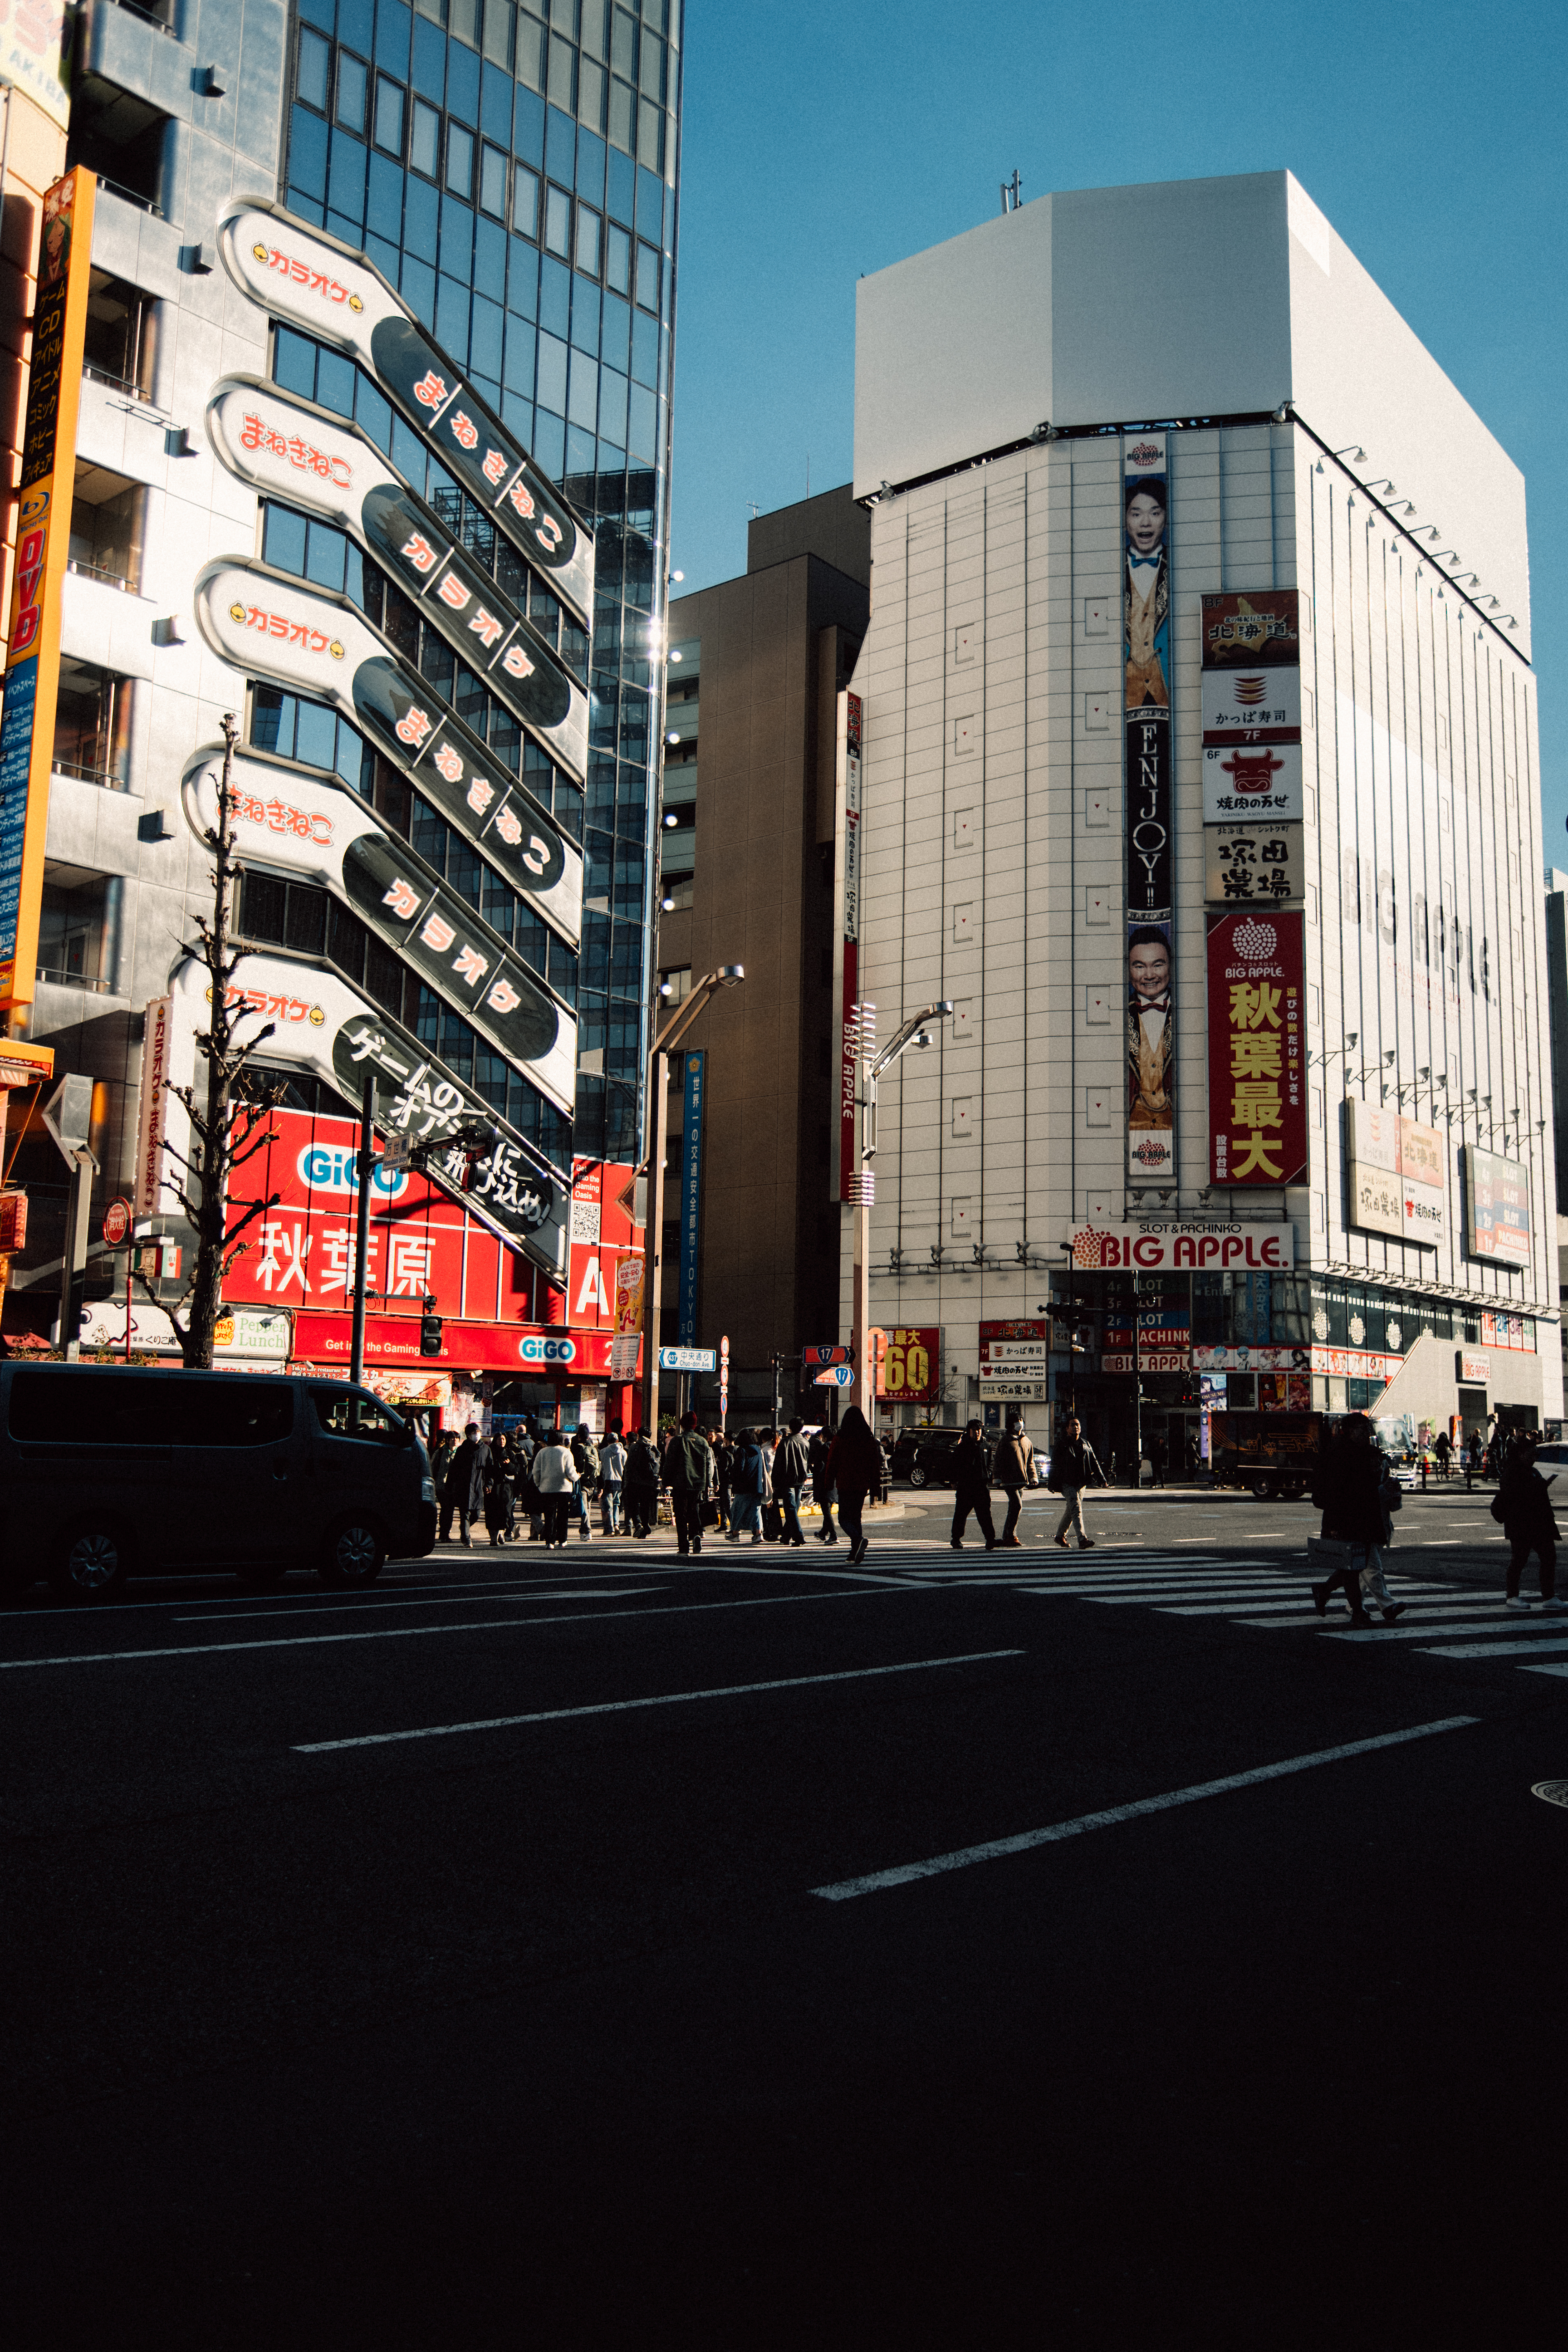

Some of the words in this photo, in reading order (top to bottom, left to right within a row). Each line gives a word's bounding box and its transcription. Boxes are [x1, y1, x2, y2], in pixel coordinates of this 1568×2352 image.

[268, 248, 350, 305] カラオケ
[39, 310, 61, 340] CD
[34, 336, 62, 371] アイドル
[31, 363, 61, 401] アニメ
[29, 394, 57, 425] コミック
[29, 427, 54, 455] ホビー
[239, 412, 354, 490] まねきねこ
[1127, 452, 1140, 461] BIG
[1142, 451, 1164, 459] APPLE
[25, 452, 52, 483] フィギュア
[414, 370, 563, 552] まねきねこ
[11, 527, 46, 654] DVD
[401, 532, 535, 679] カラオケ
[1204, 597, 1223, 608] 8F
[1224, 614, 1275, 624] 北の味紀行と地酒
[246, 607, 330, 654] カラオケ
[1209, 622, 1291, 641] 北海道
[848, 699, 860, 745] 北海道
[1216, 710, 1286, 725] かっぱ寿司
[1243, 730, 1261, 741] 7F
[850, 748, 858, 757] 8F
[1207, 750, 1221, 760] 6F
[396, 707, 550, 875] まねきねこ
[1216, 794, 1289, 810] 焼肉の万世
[216, 783, 334, 847] まねきねこ
[1218, 826, 1245, 835] 北海道
[1258, 825, 1290, 834] シントク町
[1218, 839, 1289, 867] 塚田
[1343, 845, 1399, 947] BIG
[846, 891, 856, 935] 塚田農場
[381, 877, 521, 1013] カラオケ
[848, 935, 854, 944] 5F
[1225, 967, 1246, 978] BIG
[226, 984, 311, 1023] カラオケ
[151, 1020, 165, 1090] カラオケ
[1287, 987, 1299, 1105] 遊びの数だけ楽しさを
[350, 1027, 464, 1116] ゲームの
[1229, 982, 1284, 1179] 秋葉最大
[843, 1064, 854, 1119] APPLE
[386, 1138, 408, 1156] 万世橋
[1132, 1150, 1146, 1159] BIG
[1148, 1149, 1171, 1158] APPLE
[144, 1107, 160, 1208] まねきねこ
[1216, 1135, 1227, 1178] 設置台数
[1404, 1142, 1439, 1172] 北海道
[576, 1164, 587, 1173] Get
[577, 1173, 589, 1181] into
[1503, 1165, 1517, 1183] SLOT
[575, 1182, 600, 1193] Gaming
[575, 1190, 593, 1200] Oasis
[1503, 1187, 1518, 1205] SLOT
[1361, 1187, 1399, 1218] 塚田農場
[1415, 1203, 1441, 1223] 焼肉の万世
[1503, 1209, 1519, 1227] SLOT
[109, 1215, 125, 1232] 消火栓
[1140, 1224, 1169, 1234] SLOT
[1171, 1224, 1179, 1234] &
[1180, 1224, 1242, 1234] PACHINKO
[1498, 1229, 1528, 1251] PACHINKO
[256, 1222, 436, 1296] 秋葉原
[1100, 1236, 1165, 1267] BIG
[1174, 1236, 1289, 1267] APPLE.
[620, 1263, 640, 1271] みんなで協力
[620, 1269, 640, 1279] 安全・安心
[620, 1276, 640, 1285] 元気なアキバ
[1107, 1281, 1122, 1292] 4F
[1139, 1279, 1164, 1291] LOT
[1107, 1297, 1122, 1309] 3F
[1139, 1296, 1164, 1308] LOT
[240, 1318, 285, 1333] Pepper
[1107, 1314, 1122, 1326] 2F
[1139, 1314, 1164, 1325] LOT
[1482, 1312, 1494, 1332] 1階
[1496, 1314, 1508, 1333] 2階
[1510, 1316, 1521, 1336] 3階
[145, 1335, 177, 1346] くりこ庵
[239, 1333, 284, 1348] Lunch
[998, 1327, 1040, 1339] 北海道
[1107, 1331, 1121, 1343] 1F
[1131, 1330, 1190, 1343] ACHINK
[326, 1339, 344, 1350] Get
[367, 1341, 381, 1352] the
[384, 1343, 420, 1356] Gaming
[522, 1339, 573, 1359] GiGO
[681, 1352, 709, 1361] 中央通り
[821, 1348, 831, 1360] 17
[1007, 1347, 1042, 1355] かっぱ寿司
[993, 1365, 1029, 1374] 焼肉の万世
[1148, 1356, 1191, 1371] APPL
[342, 1368, 379, 1380] フスカ
[998, 1384, 1031, 1395] 塚田農場
[1202, 1390, 1225, 1400] OSUSUME
